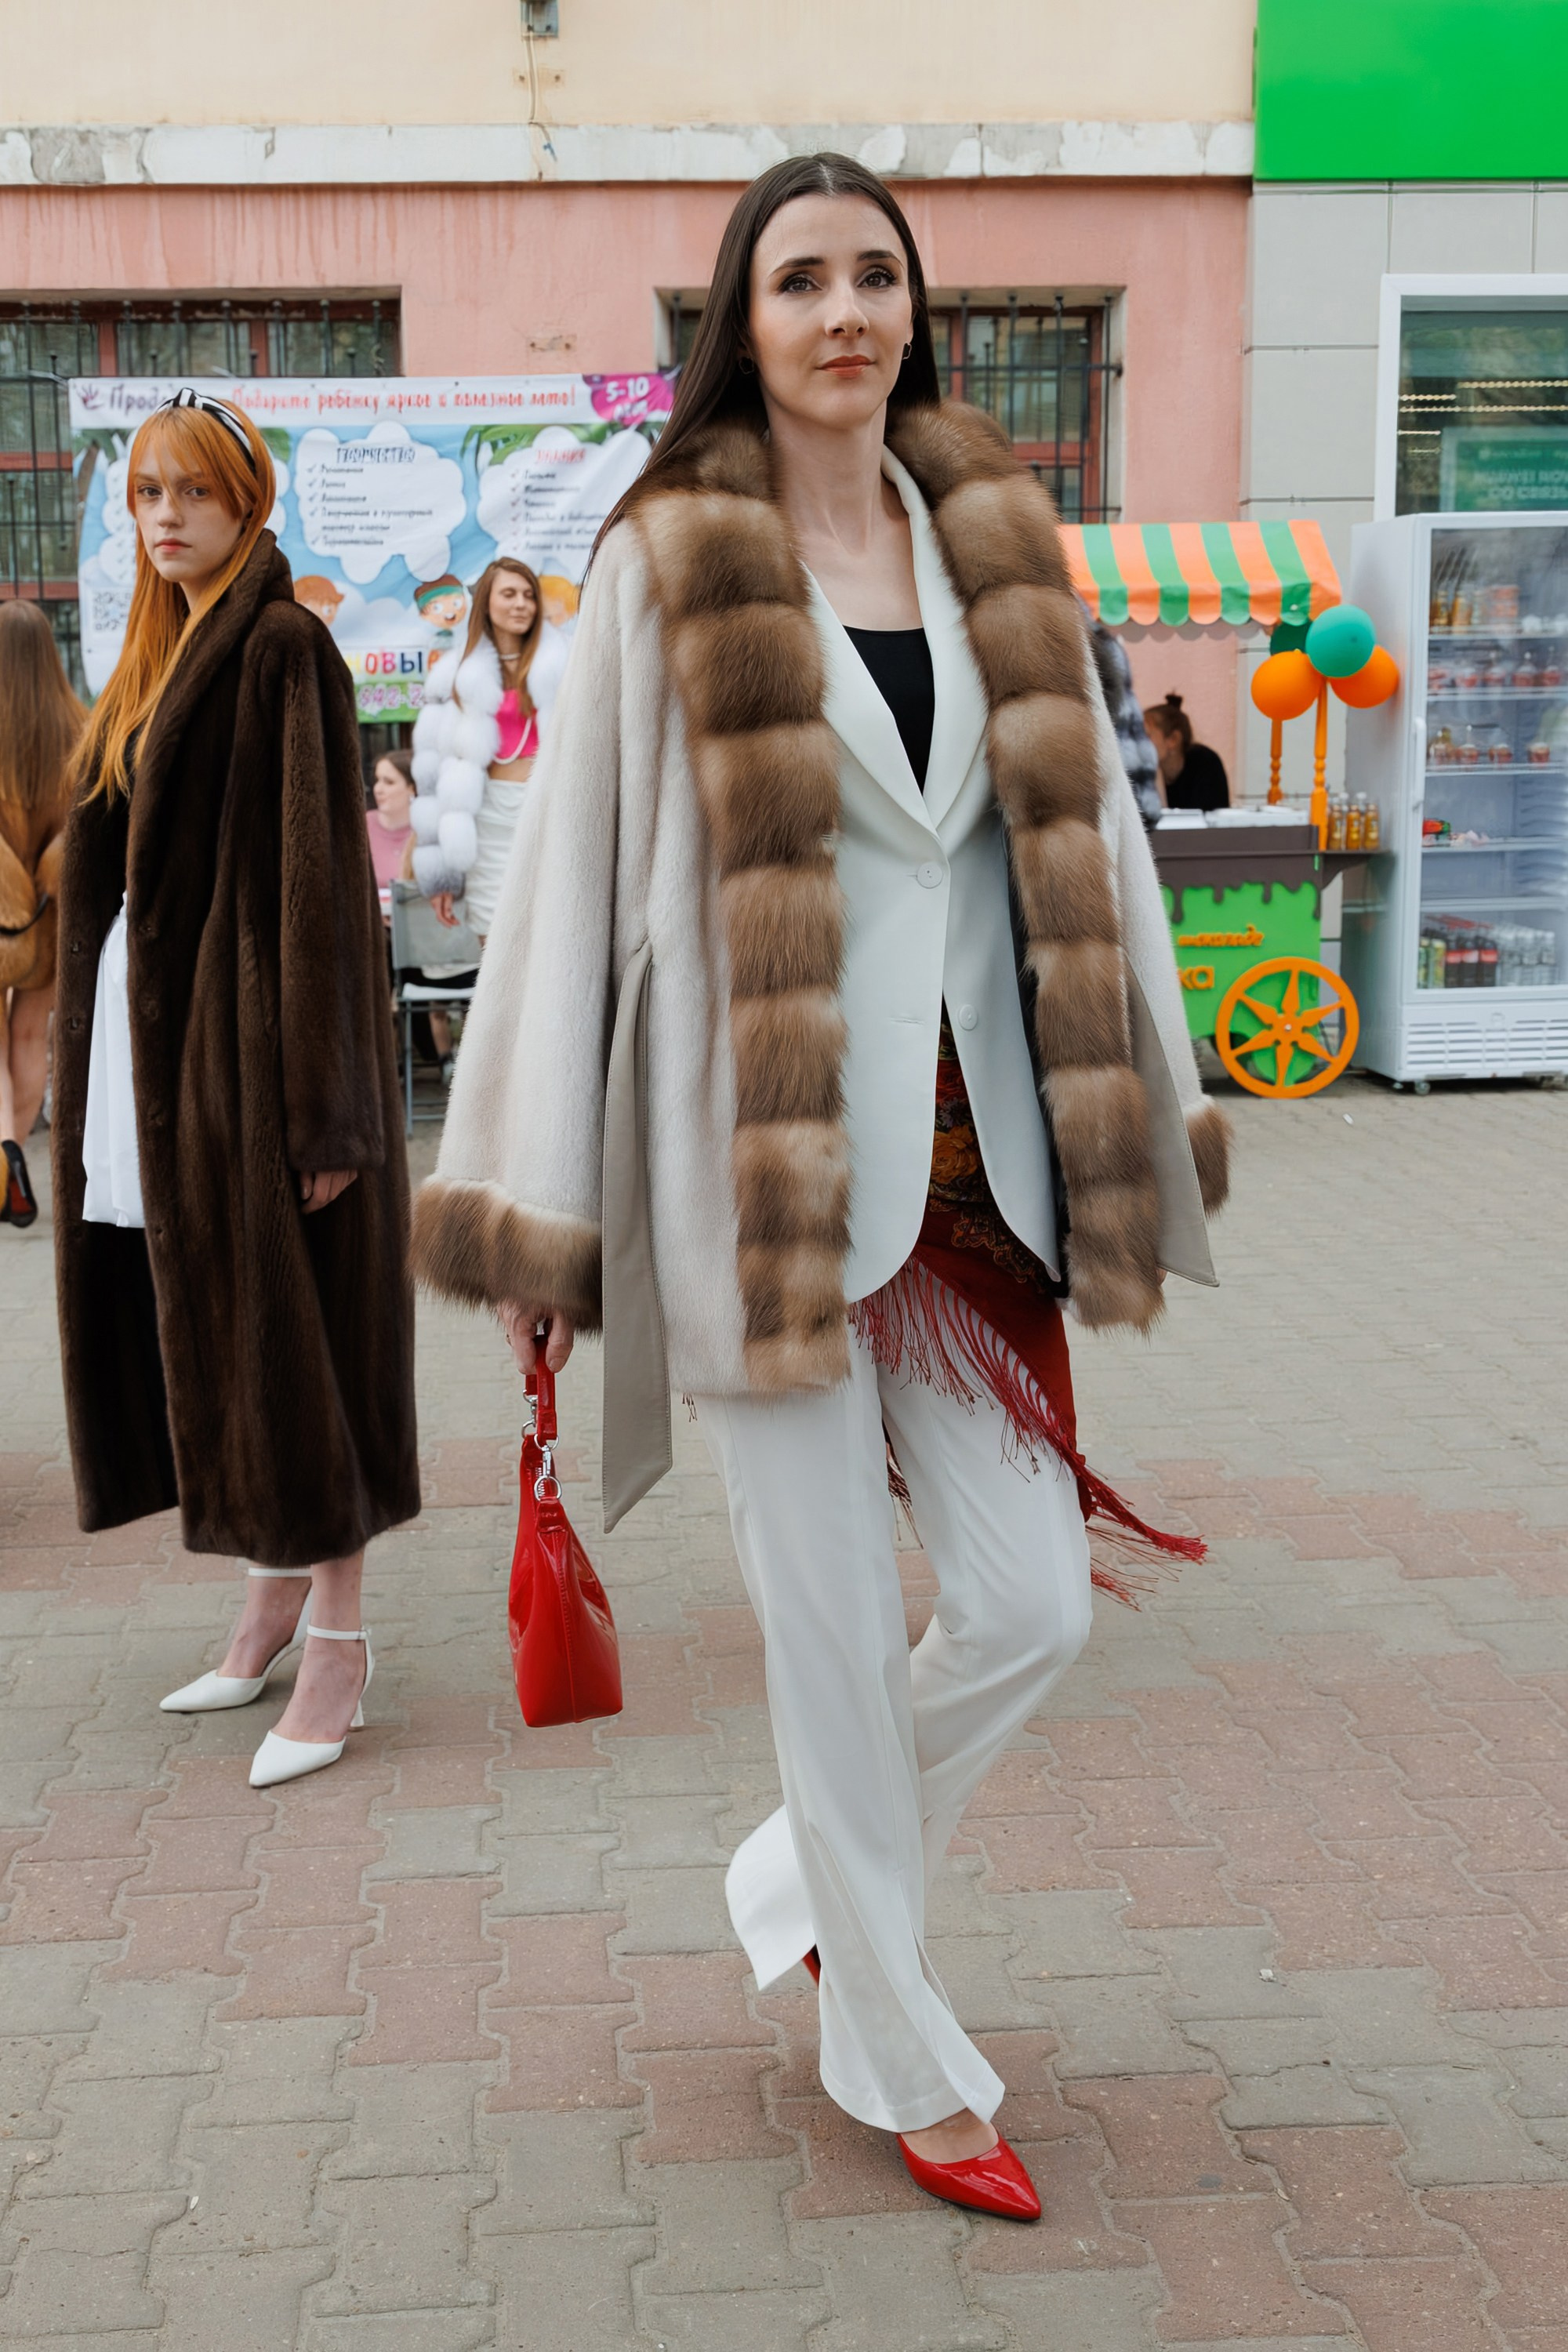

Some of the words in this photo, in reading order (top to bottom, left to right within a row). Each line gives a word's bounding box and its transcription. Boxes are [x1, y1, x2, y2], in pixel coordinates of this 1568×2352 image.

[318, 389, 379, 415] ребёнку
[387, 393, 431, 413] яркое
[606, 376, 650, 402] 5-10
